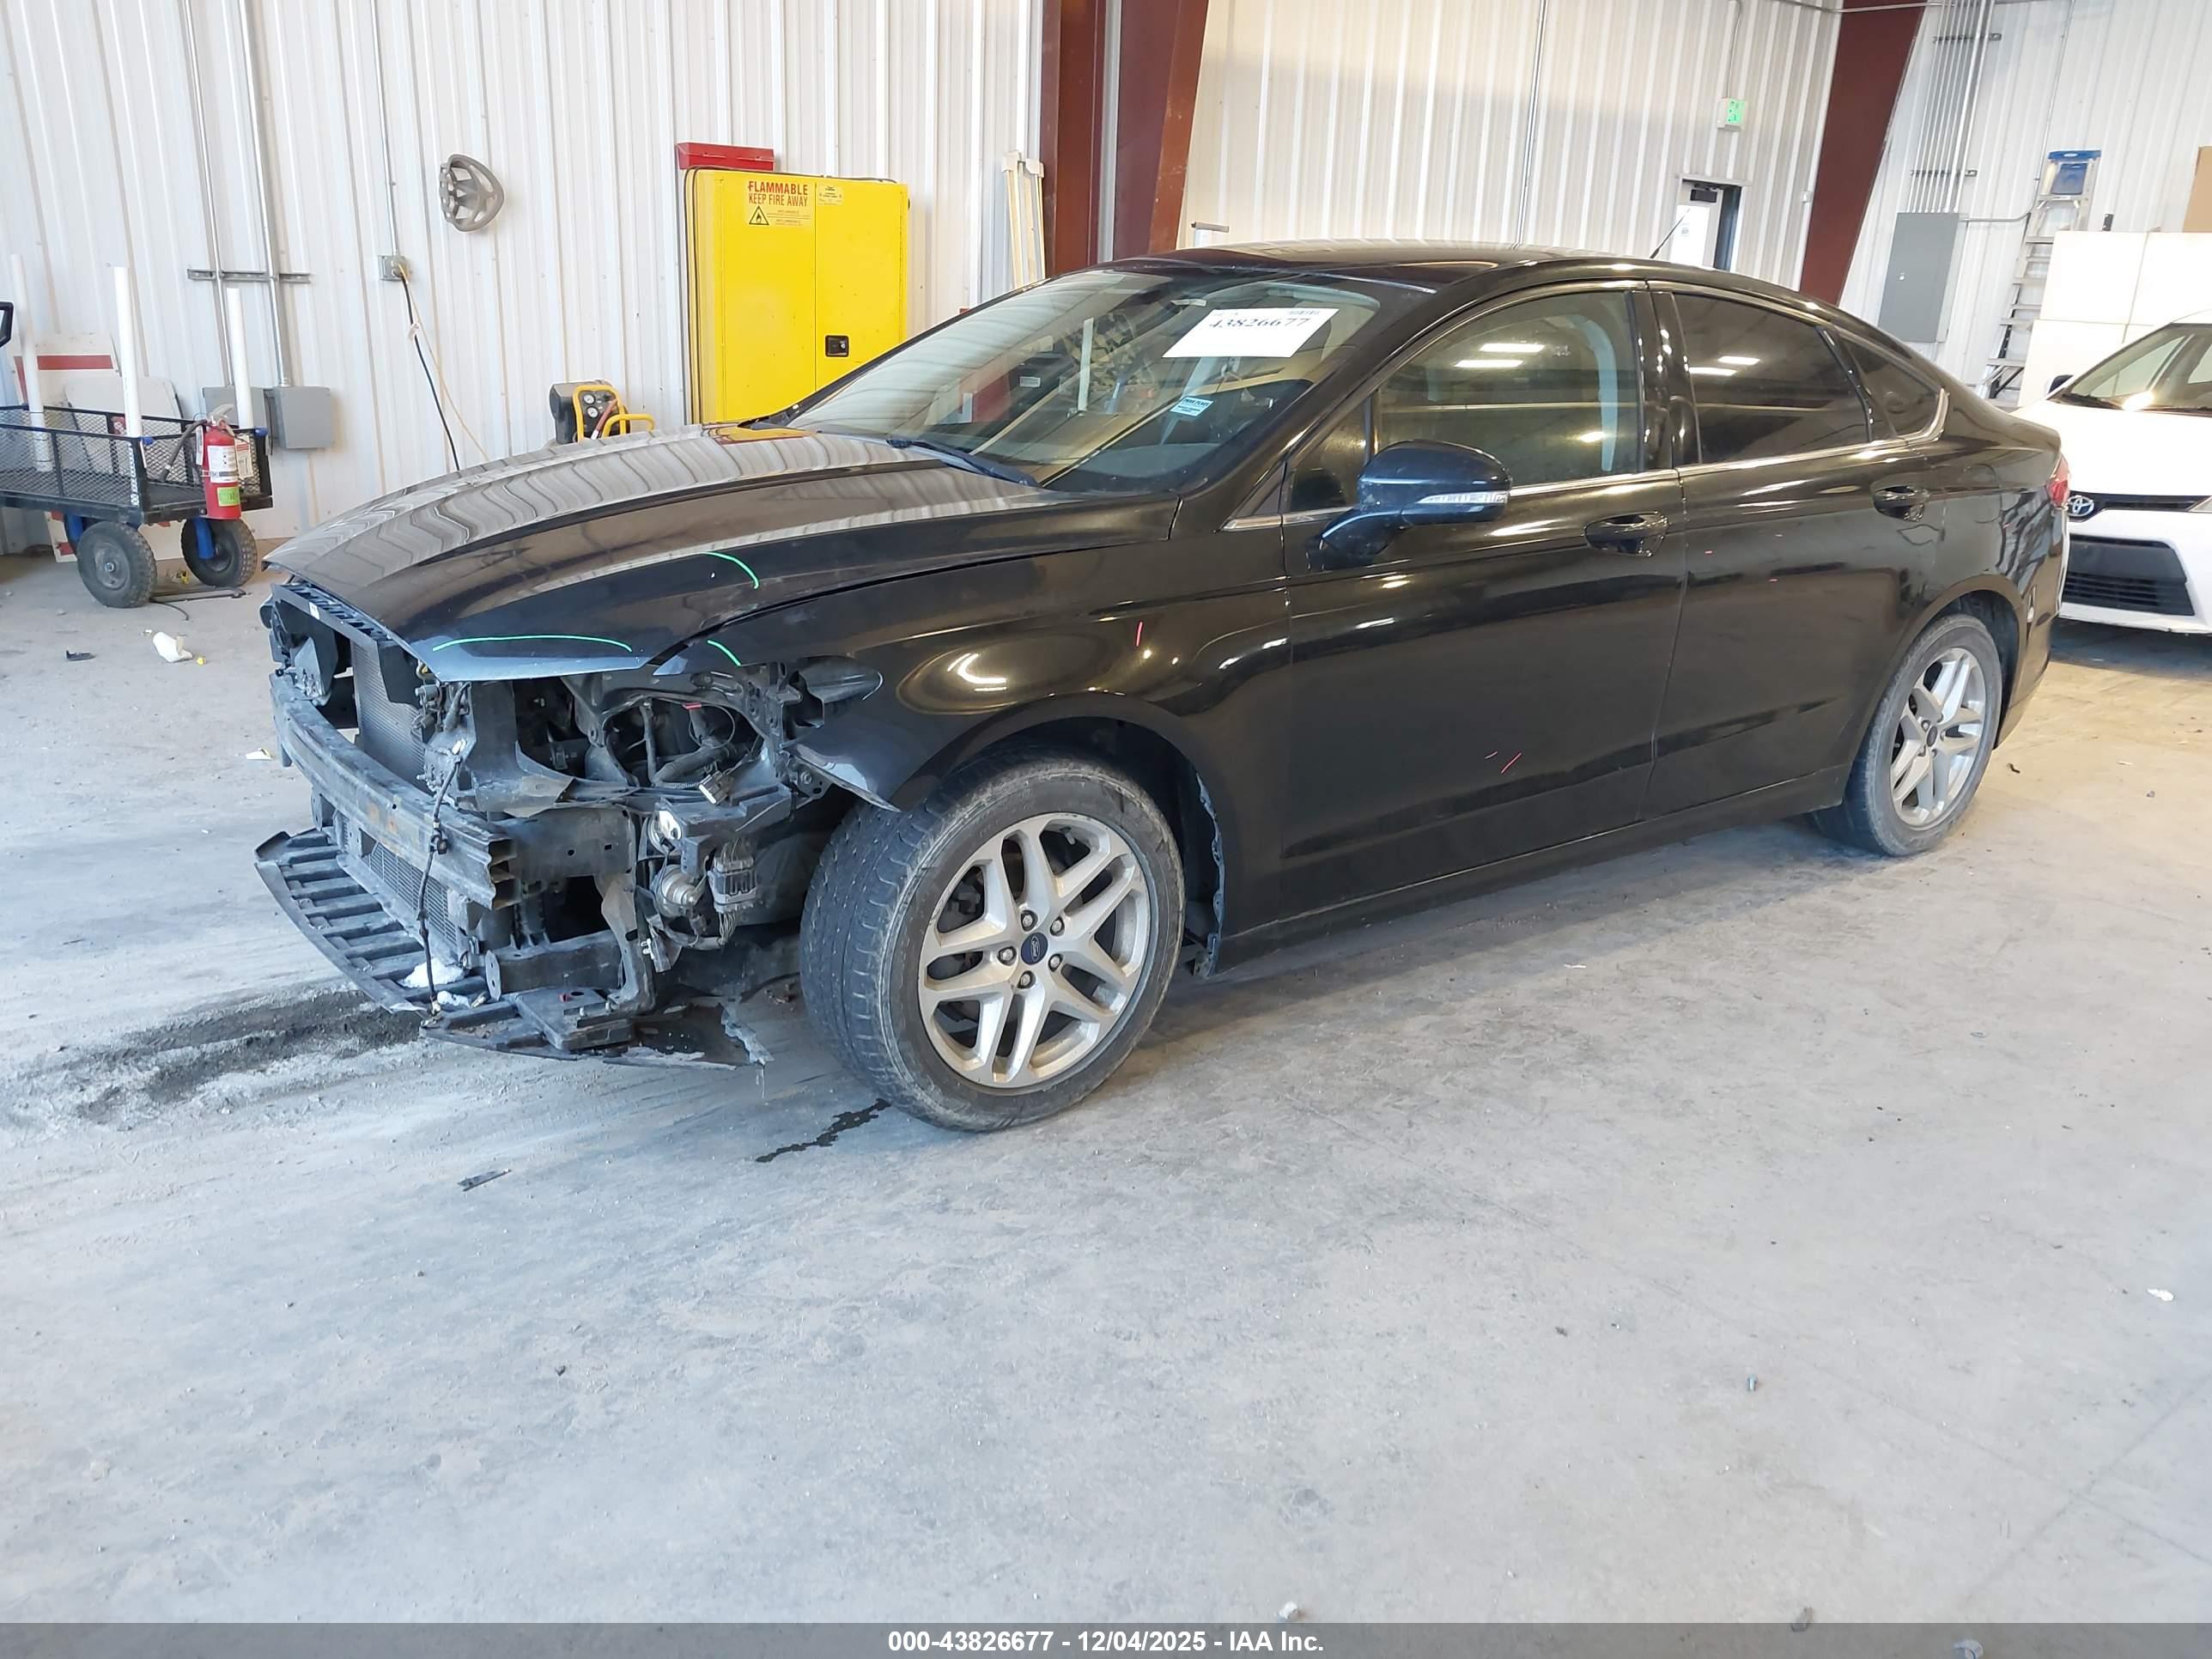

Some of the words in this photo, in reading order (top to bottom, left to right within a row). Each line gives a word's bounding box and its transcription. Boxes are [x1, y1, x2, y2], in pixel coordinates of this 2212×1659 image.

[748, 180, 809, 196] FLAMMABLE
[749, 193, 767, 204] KEEP
[769, 194, 785, 206] FIRE
[787, 195, 808, 207] AWAY
